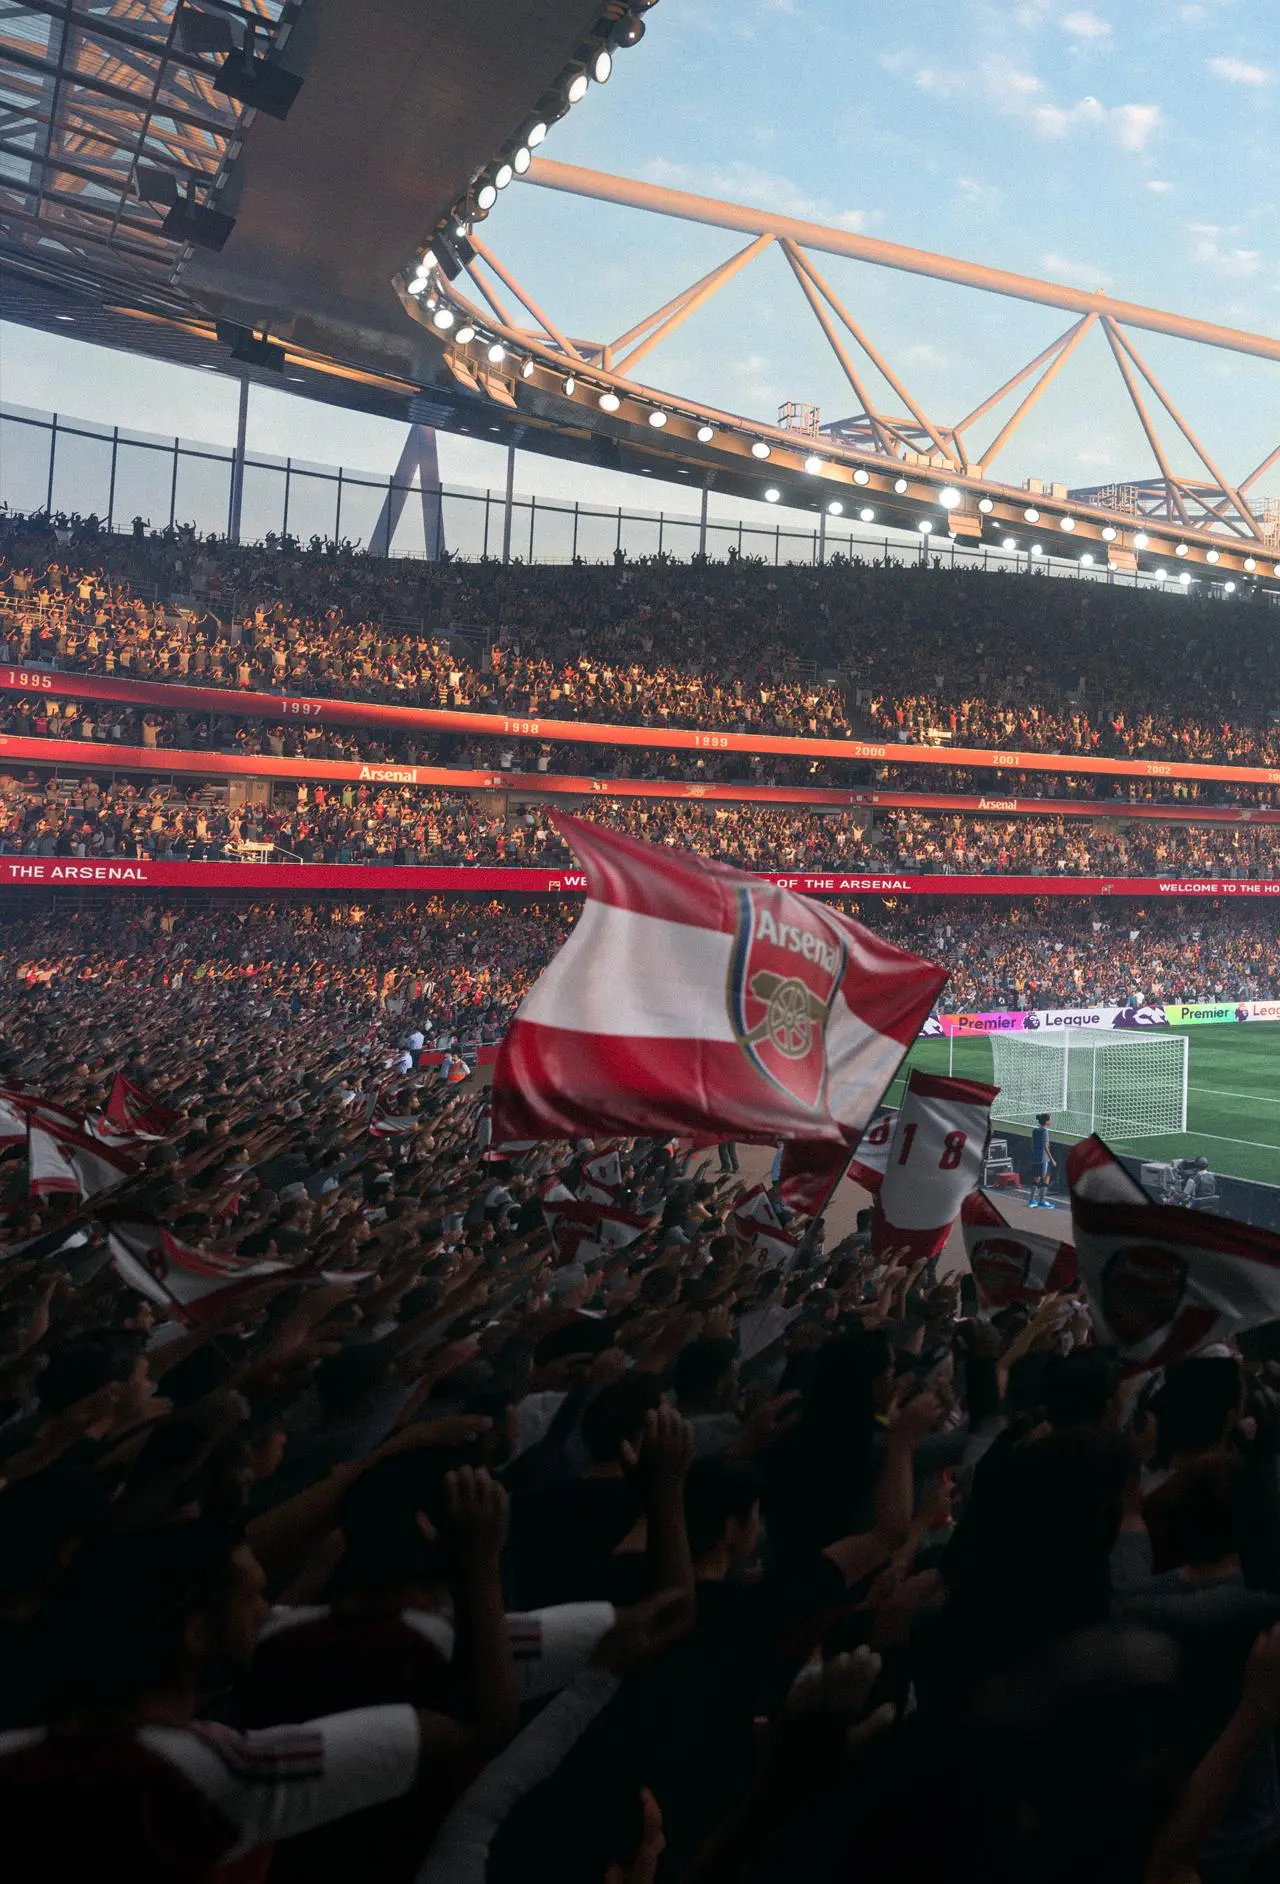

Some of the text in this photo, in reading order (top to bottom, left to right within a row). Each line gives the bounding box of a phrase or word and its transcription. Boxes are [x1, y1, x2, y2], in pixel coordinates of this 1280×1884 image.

[8, 671, 52, 689] 1995
[281, 701, 322, 716] 1997
[503, 720, 539, 734] 1998
[695, 735, 728, 748] 1999
[855, 746, 886, 757] 2000
[992, 754, 1019, 766] 2001
[359, 766, 417, 783] Arsenal
[1146, 764, 1172, 776] 2002
[978, 799, 1017, 811] Arsenal
[8, 865, 148, 880] THE ARSENAL
[777, 880, 798, 889] OF
[804, 880, 834, 889] THE
[840, 880, 911, 890] ARSENAL
[1160, 883, 1218, 893] WELCOME
[1222, 884, 1237, 893] TO
[1240, 885, 1261, 893] THE
[1181, 1007, 1229, 1020] Premier
[959, 1013, 1101, 1030] Premier League
[898, 1123, 967, 1170] 1 8
